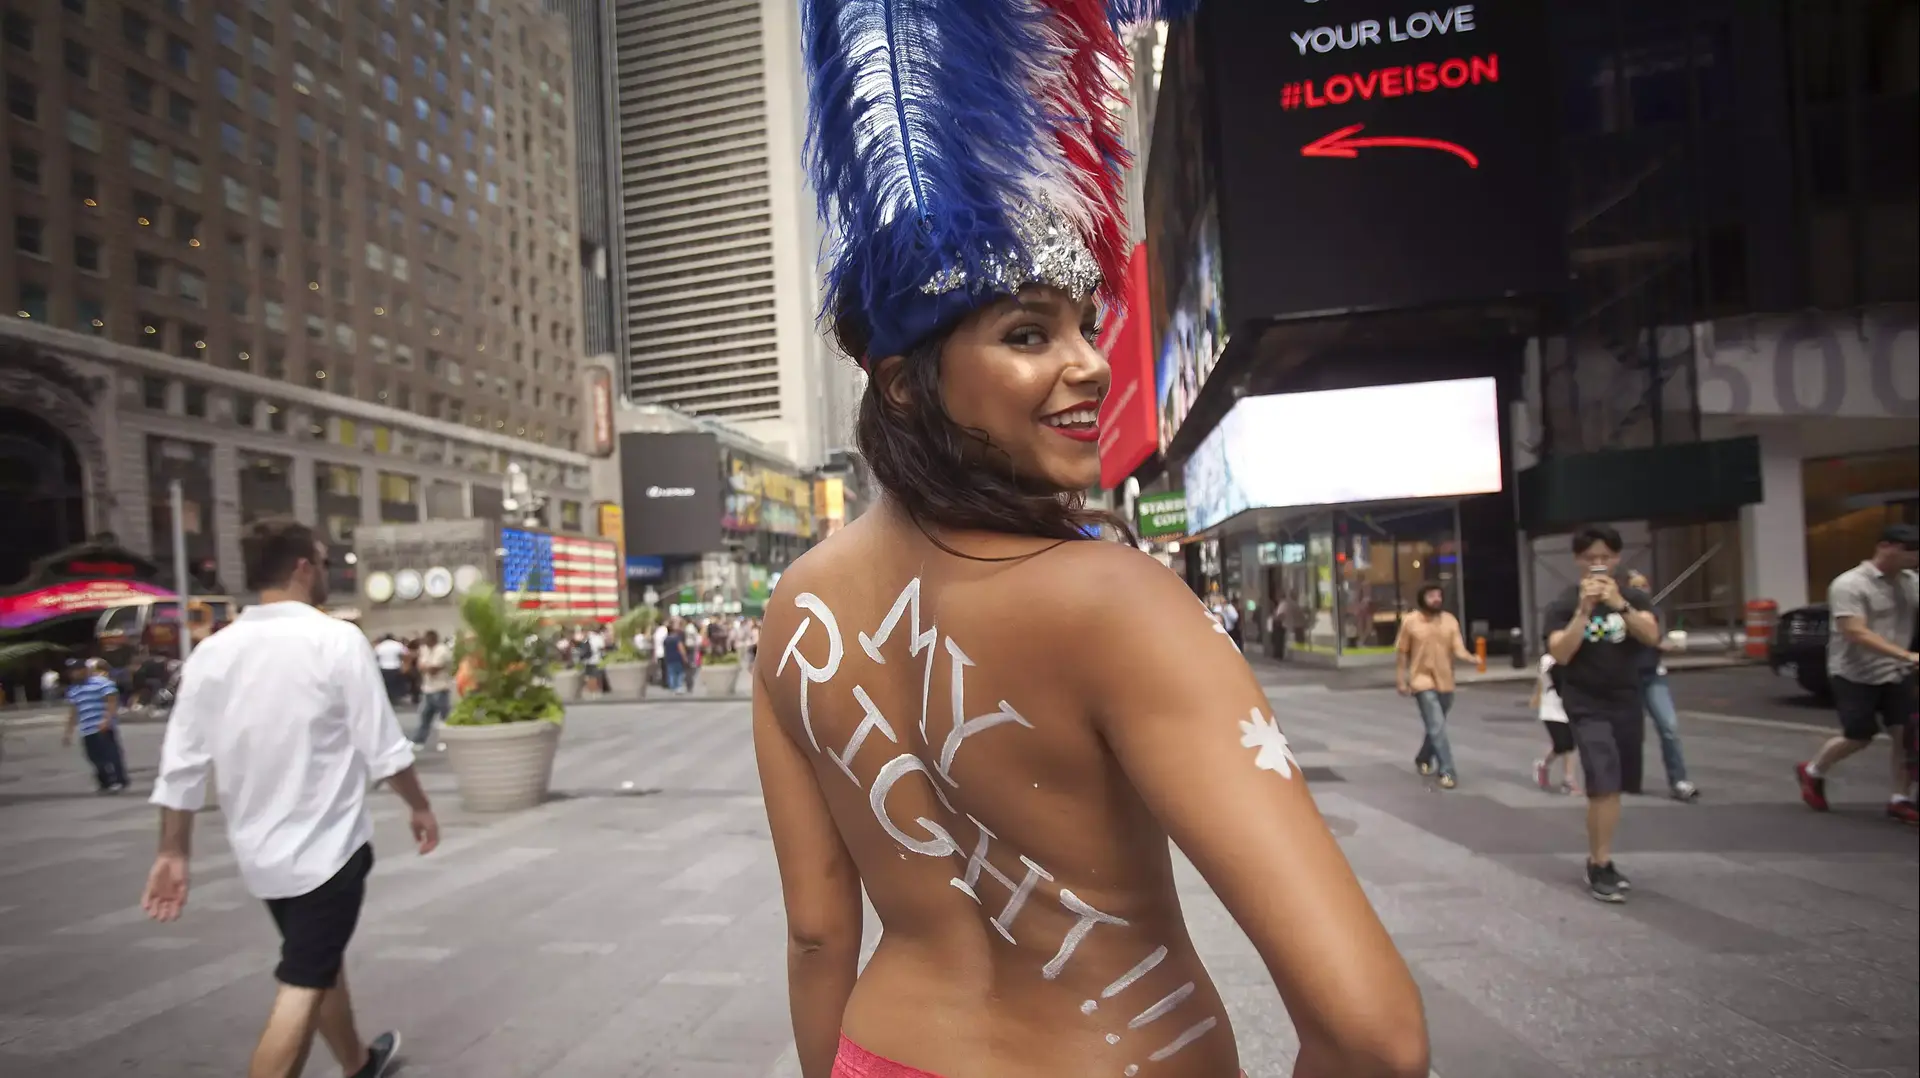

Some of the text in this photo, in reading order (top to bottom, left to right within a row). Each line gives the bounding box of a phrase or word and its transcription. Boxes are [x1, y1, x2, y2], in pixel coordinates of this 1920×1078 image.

[1290, 4, 1476, 56] YOUR LOVE
[1280, 52, 1499, 111] #LOVEISON
[858, 575, 1036, 789] MY
